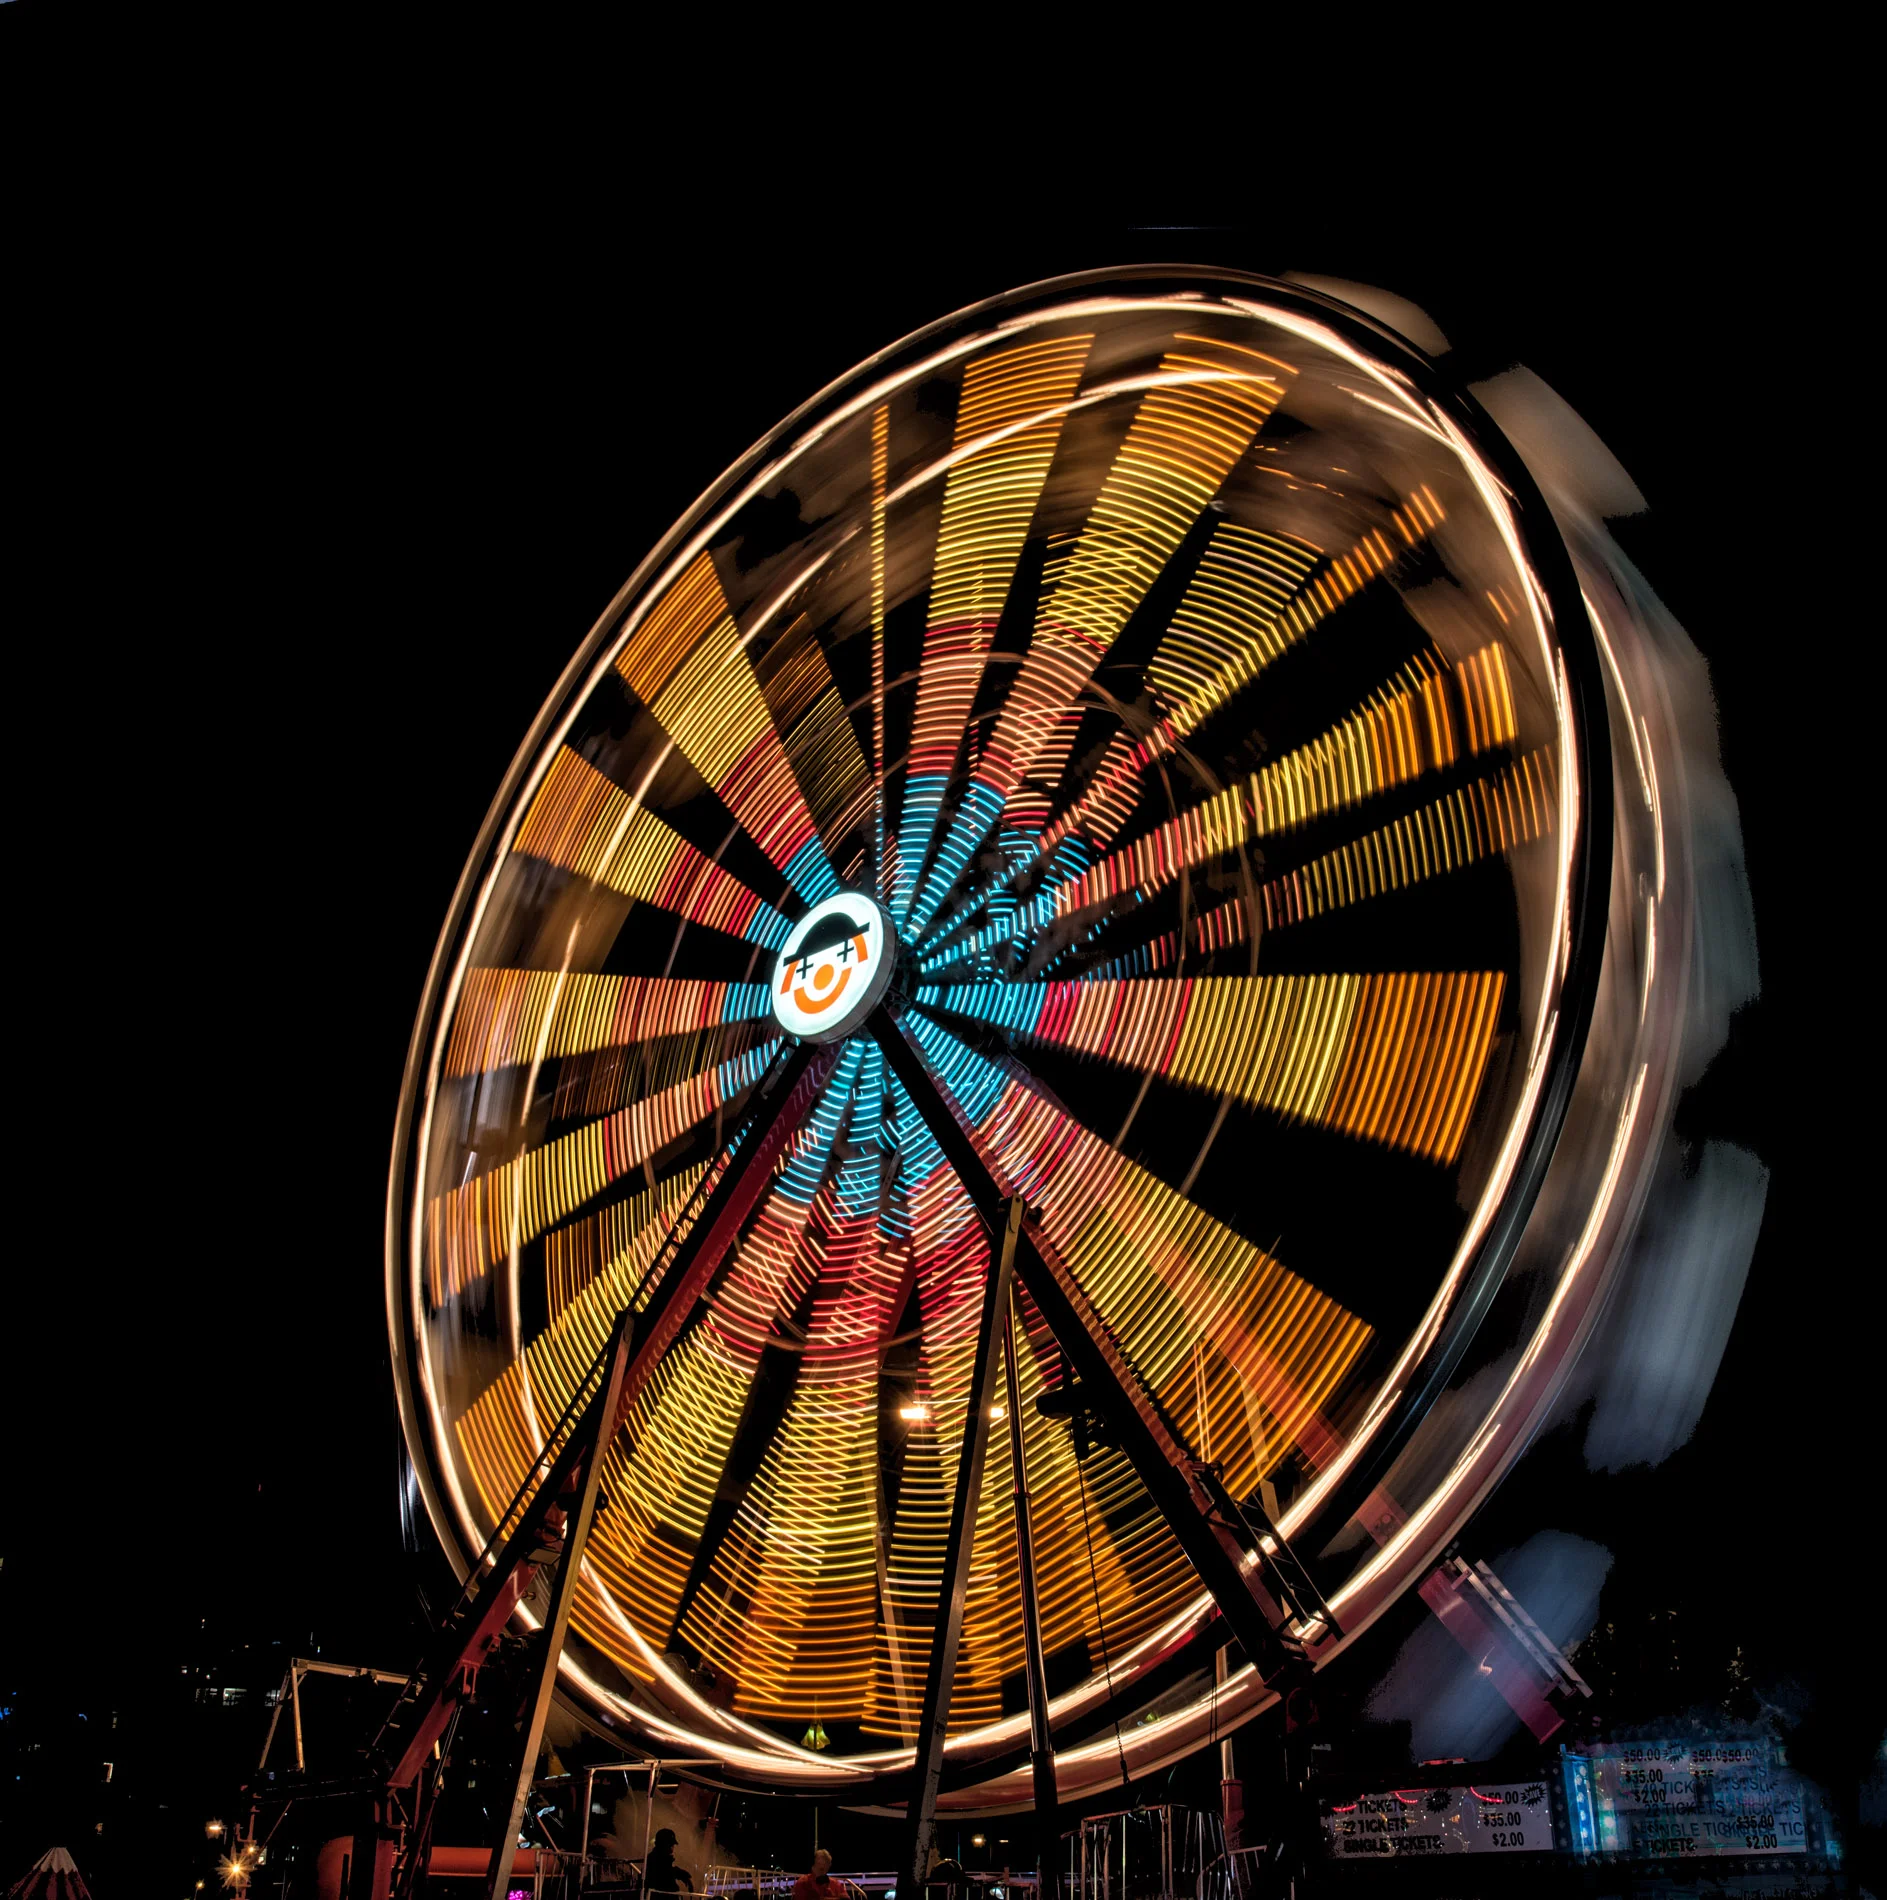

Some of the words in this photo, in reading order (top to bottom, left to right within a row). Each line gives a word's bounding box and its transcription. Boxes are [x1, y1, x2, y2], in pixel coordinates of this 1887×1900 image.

[1358, 1798, 1407, 1814] TICKETS
[1358, 1817, 1408, 1833] TICKETS
[1483, 1812, 1521, 1828] $35.00
[1492, 1831, 1525, 1848] $2.00
[1746, 1834, 1778, 1850] $2.00
